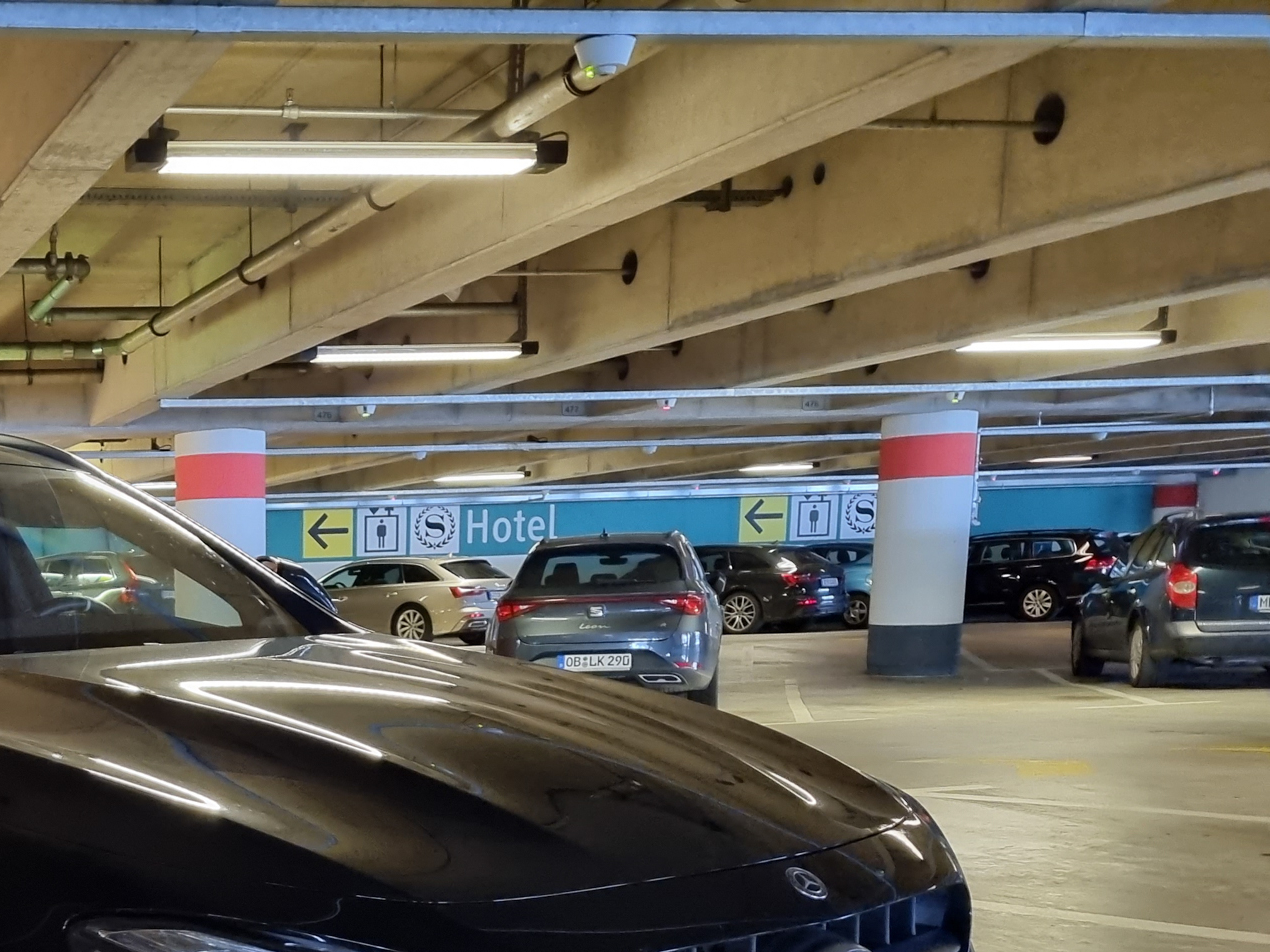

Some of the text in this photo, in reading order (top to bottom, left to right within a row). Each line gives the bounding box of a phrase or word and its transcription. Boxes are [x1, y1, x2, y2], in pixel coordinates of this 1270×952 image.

[425, 503, 558, 544] S Hotel
[565, 656, 581, 667] OB
[589, 655, 605, 667] LK
